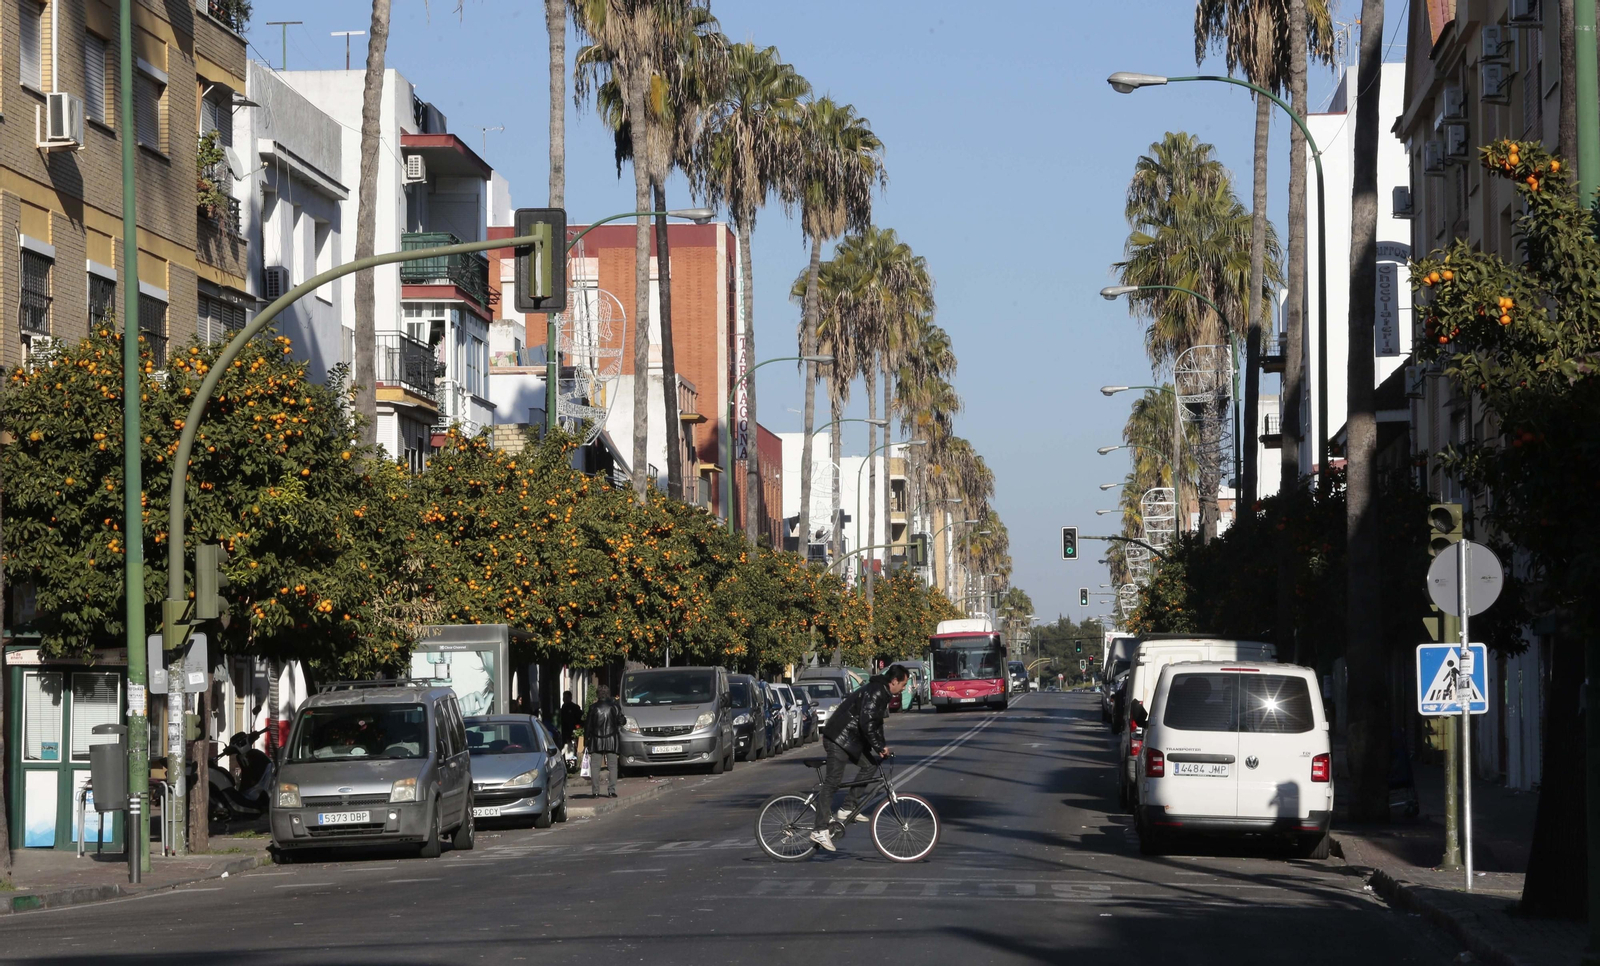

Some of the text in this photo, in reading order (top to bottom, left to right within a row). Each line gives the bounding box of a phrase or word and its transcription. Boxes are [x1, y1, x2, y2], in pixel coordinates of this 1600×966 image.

[1376, 246, 1408, 259] urros
[739, 338, 748, 459] TARRAGONA
[1181, 763, 1227, 775] 4484 JMP
[324, 812, 368, 823] 5373 DBP
[473, 808, 499, 817] 92 CCY
